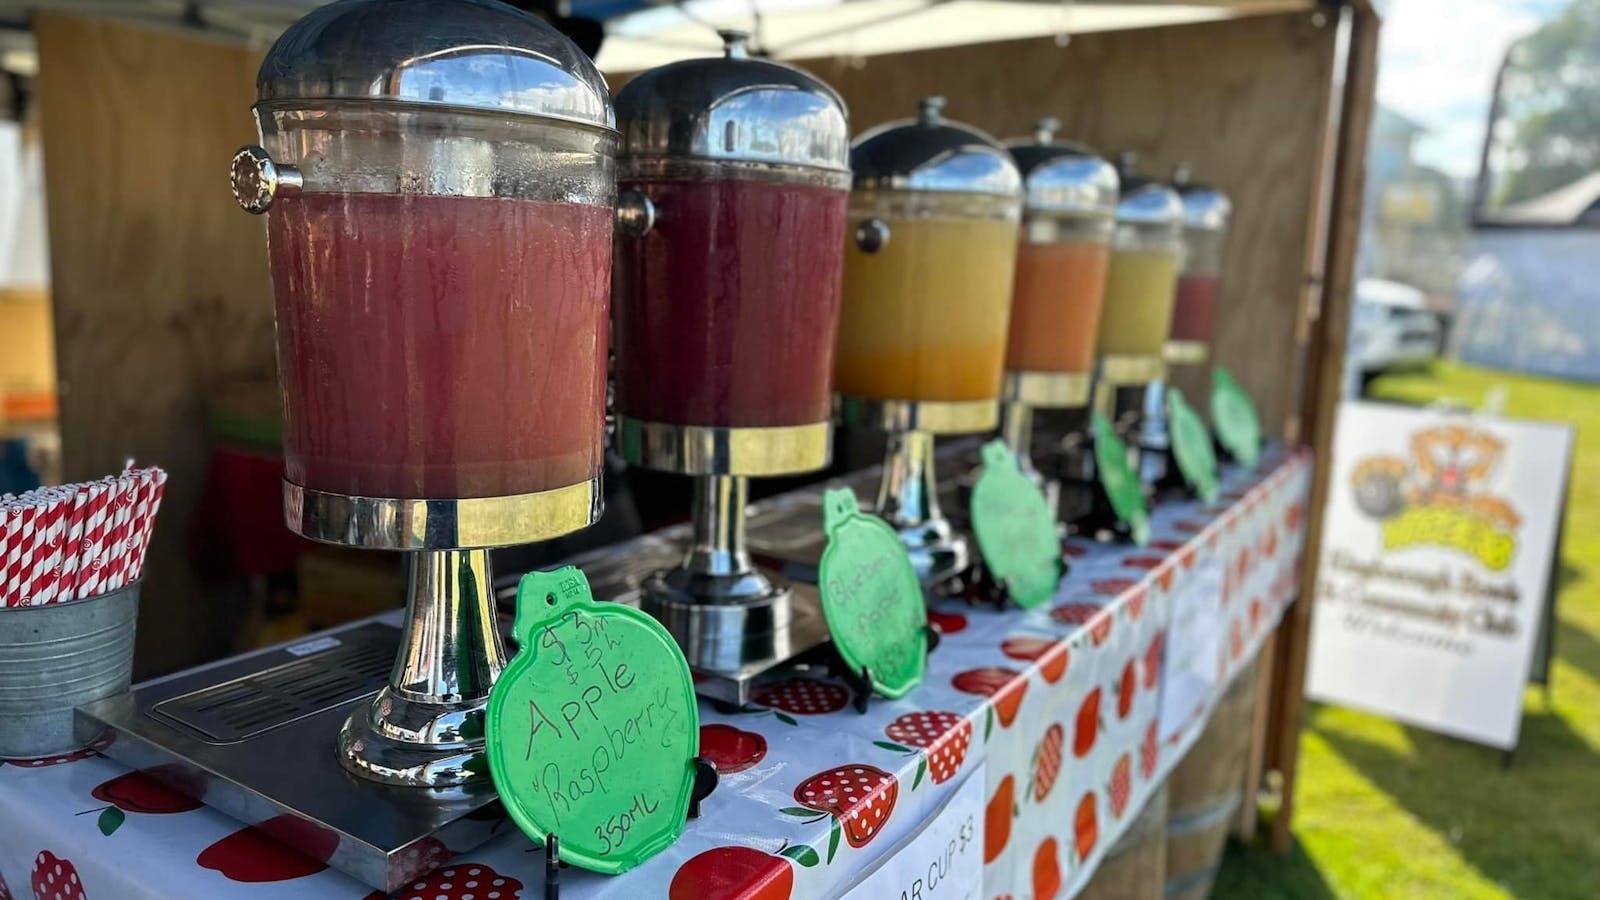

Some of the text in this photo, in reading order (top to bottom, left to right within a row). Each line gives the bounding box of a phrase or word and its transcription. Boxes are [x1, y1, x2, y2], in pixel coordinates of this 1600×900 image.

[526, 662, 636, 761] Apple
[594, 793, 660, 856] 350ML
[927, 839, 957, 891] CUP
[959, 813, 974, 855] $3
